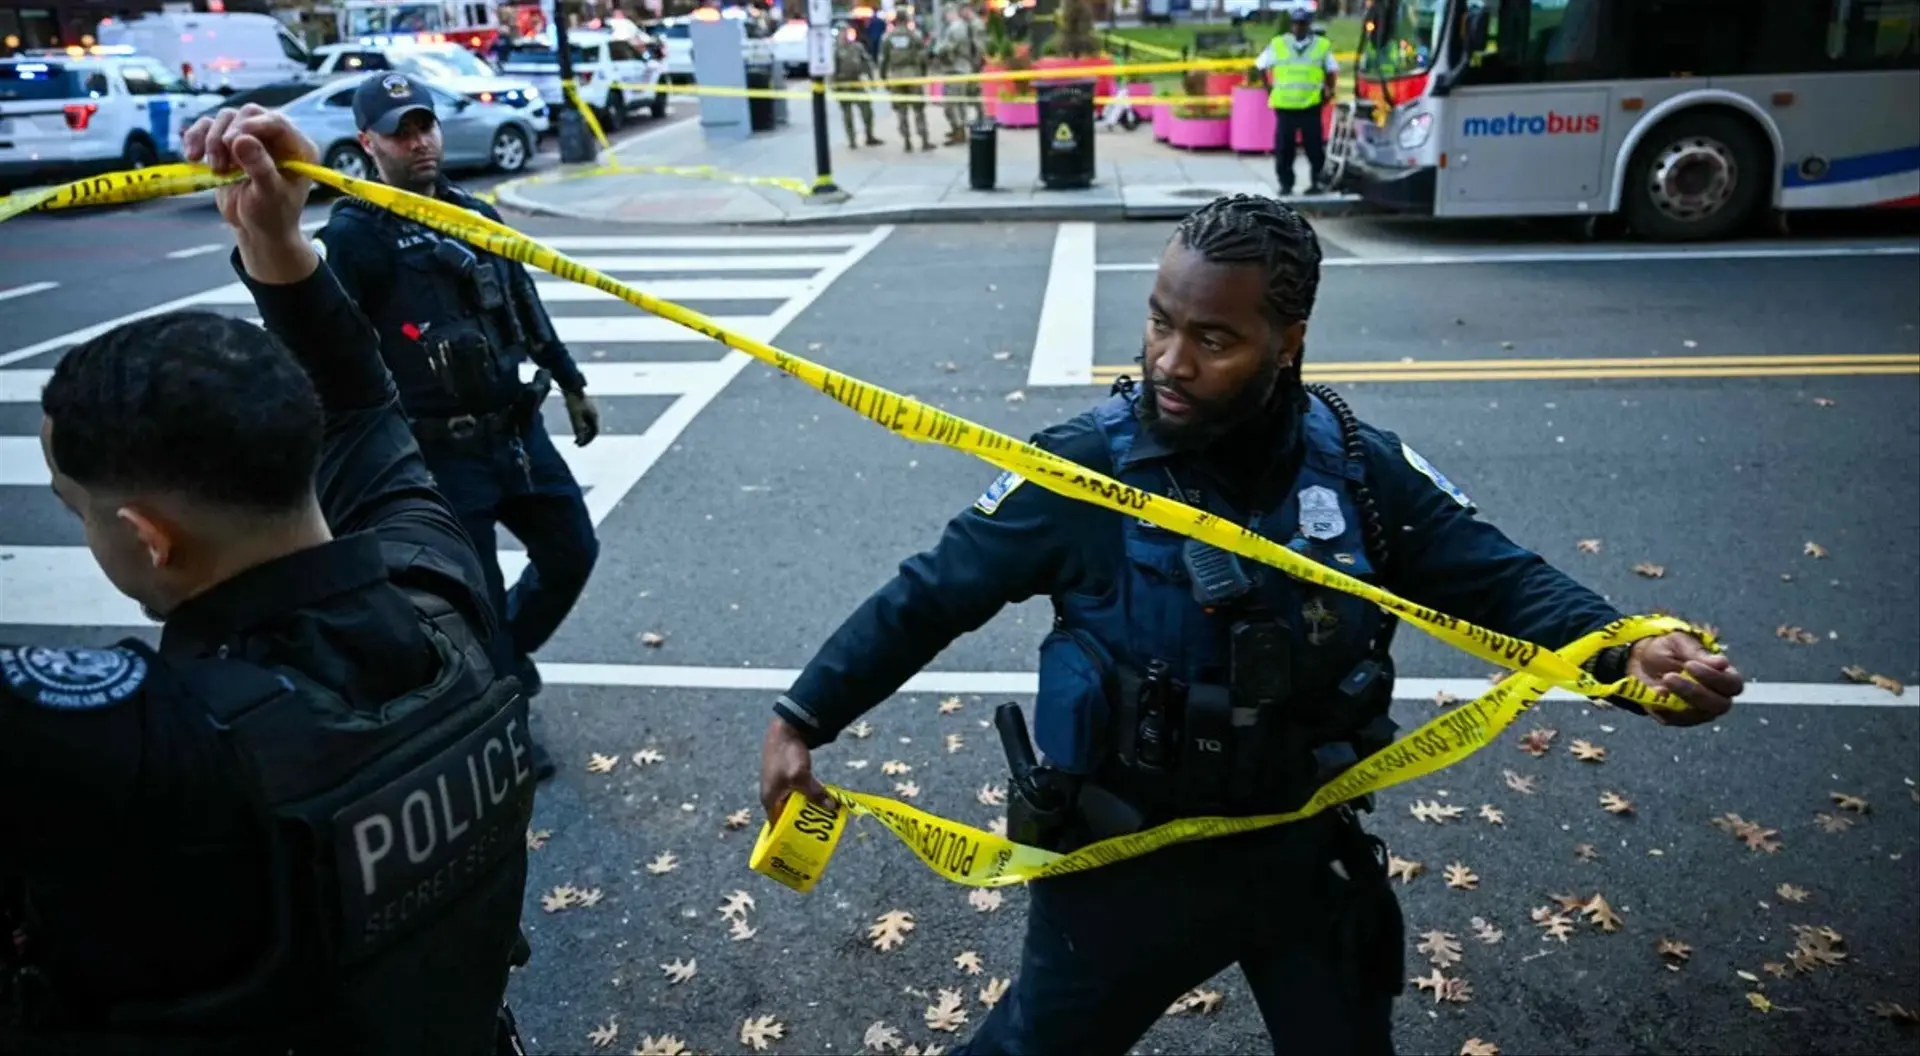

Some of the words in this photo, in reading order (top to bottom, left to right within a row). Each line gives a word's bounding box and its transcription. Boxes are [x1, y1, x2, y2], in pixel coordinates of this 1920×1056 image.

[1463, 110, 1600, 137] metrobus
[353, 717, 530, 896] POLICE
[921, 823, 980, 877] POLICE
[363, 857, 458, 945] SECRET
